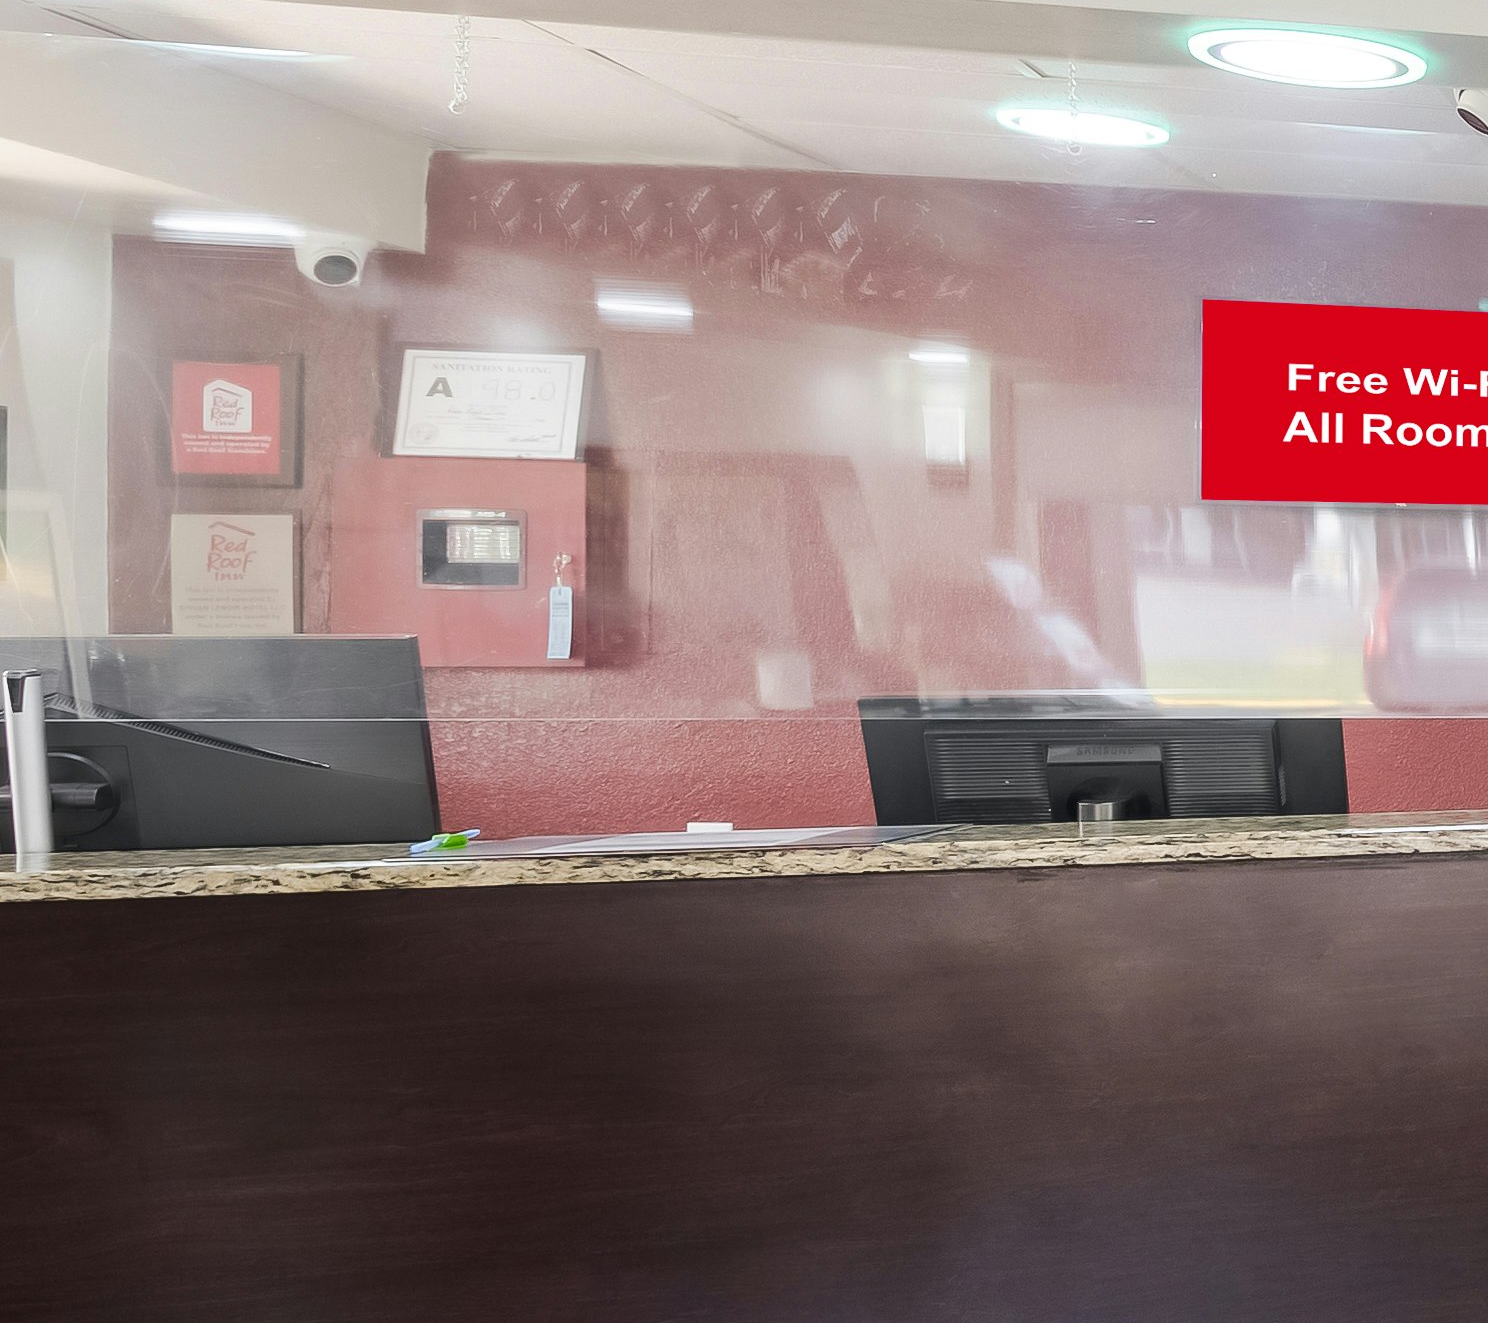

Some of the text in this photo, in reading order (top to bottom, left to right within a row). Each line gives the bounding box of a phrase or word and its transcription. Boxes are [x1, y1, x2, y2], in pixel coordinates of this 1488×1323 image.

[432, 363, 552, 375] SANITATION RATING
[425, 377, 454, 398] A
[1288, 363, 1389, 395] Free
[213, 395, 239, 408] Red
[210, 406, 245, 422] Roof
[1283, 411, 1344, 444] All
[211, 534, 248, 553] Red
[207, 550, 257, 573] Roof
[1076, 745, 1135, 756] SAMSUNG
